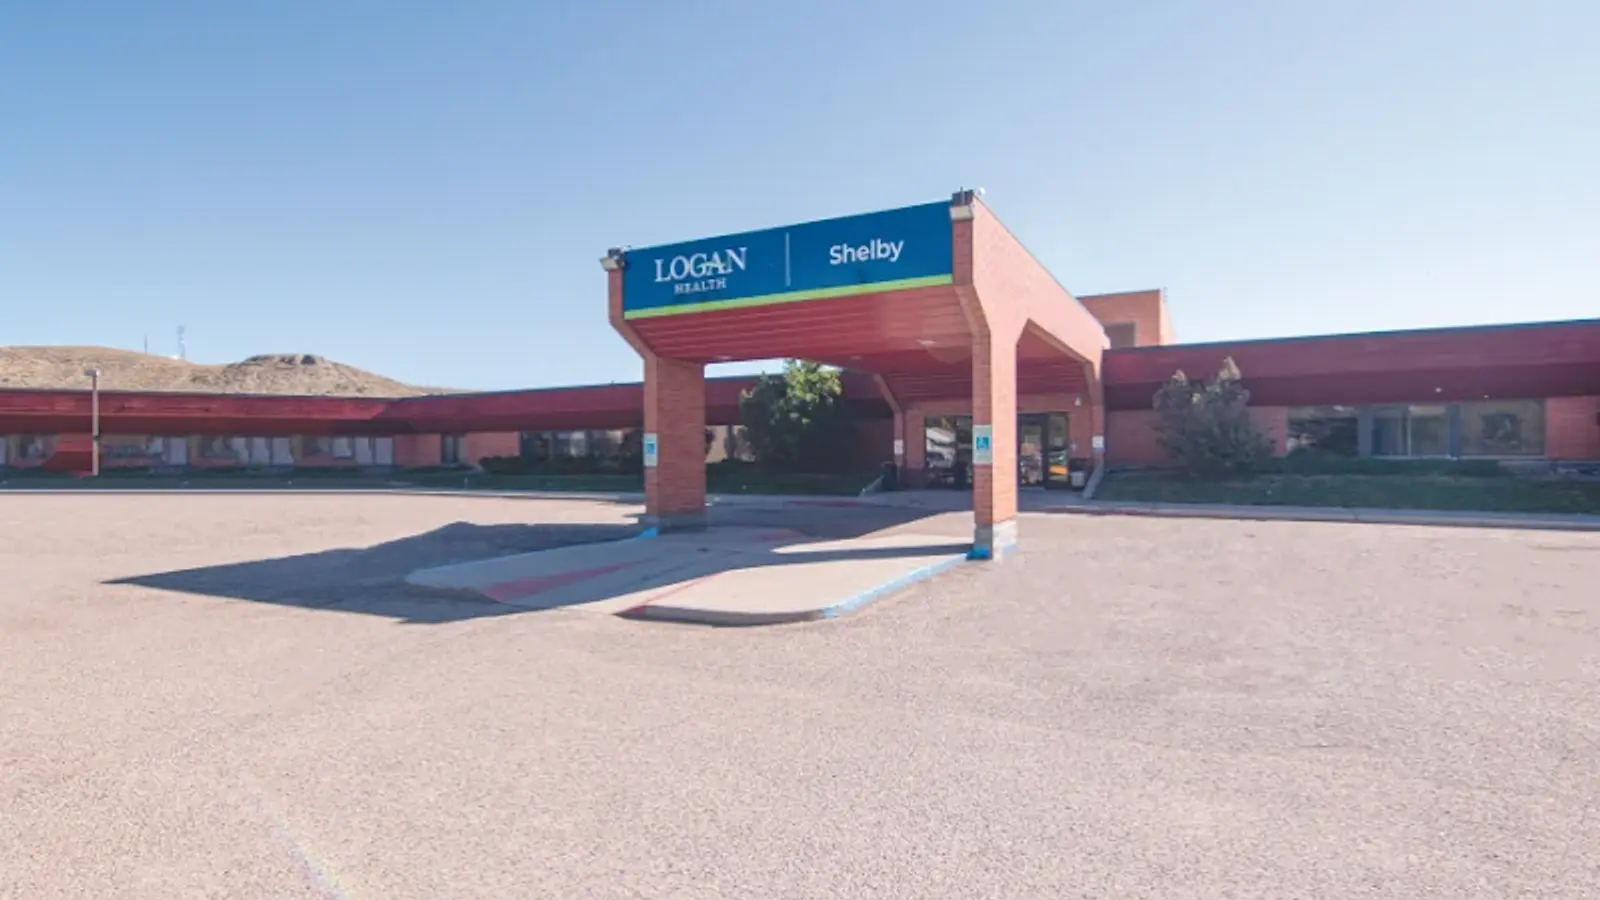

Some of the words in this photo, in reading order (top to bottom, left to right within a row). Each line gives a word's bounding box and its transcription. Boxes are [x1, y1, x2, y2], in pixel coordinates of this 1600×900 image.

[655, 247, 747, 282] LOGAN
[829, 238, 904, 265] Shelby
[674, 277, 727, 294] HEALTH
